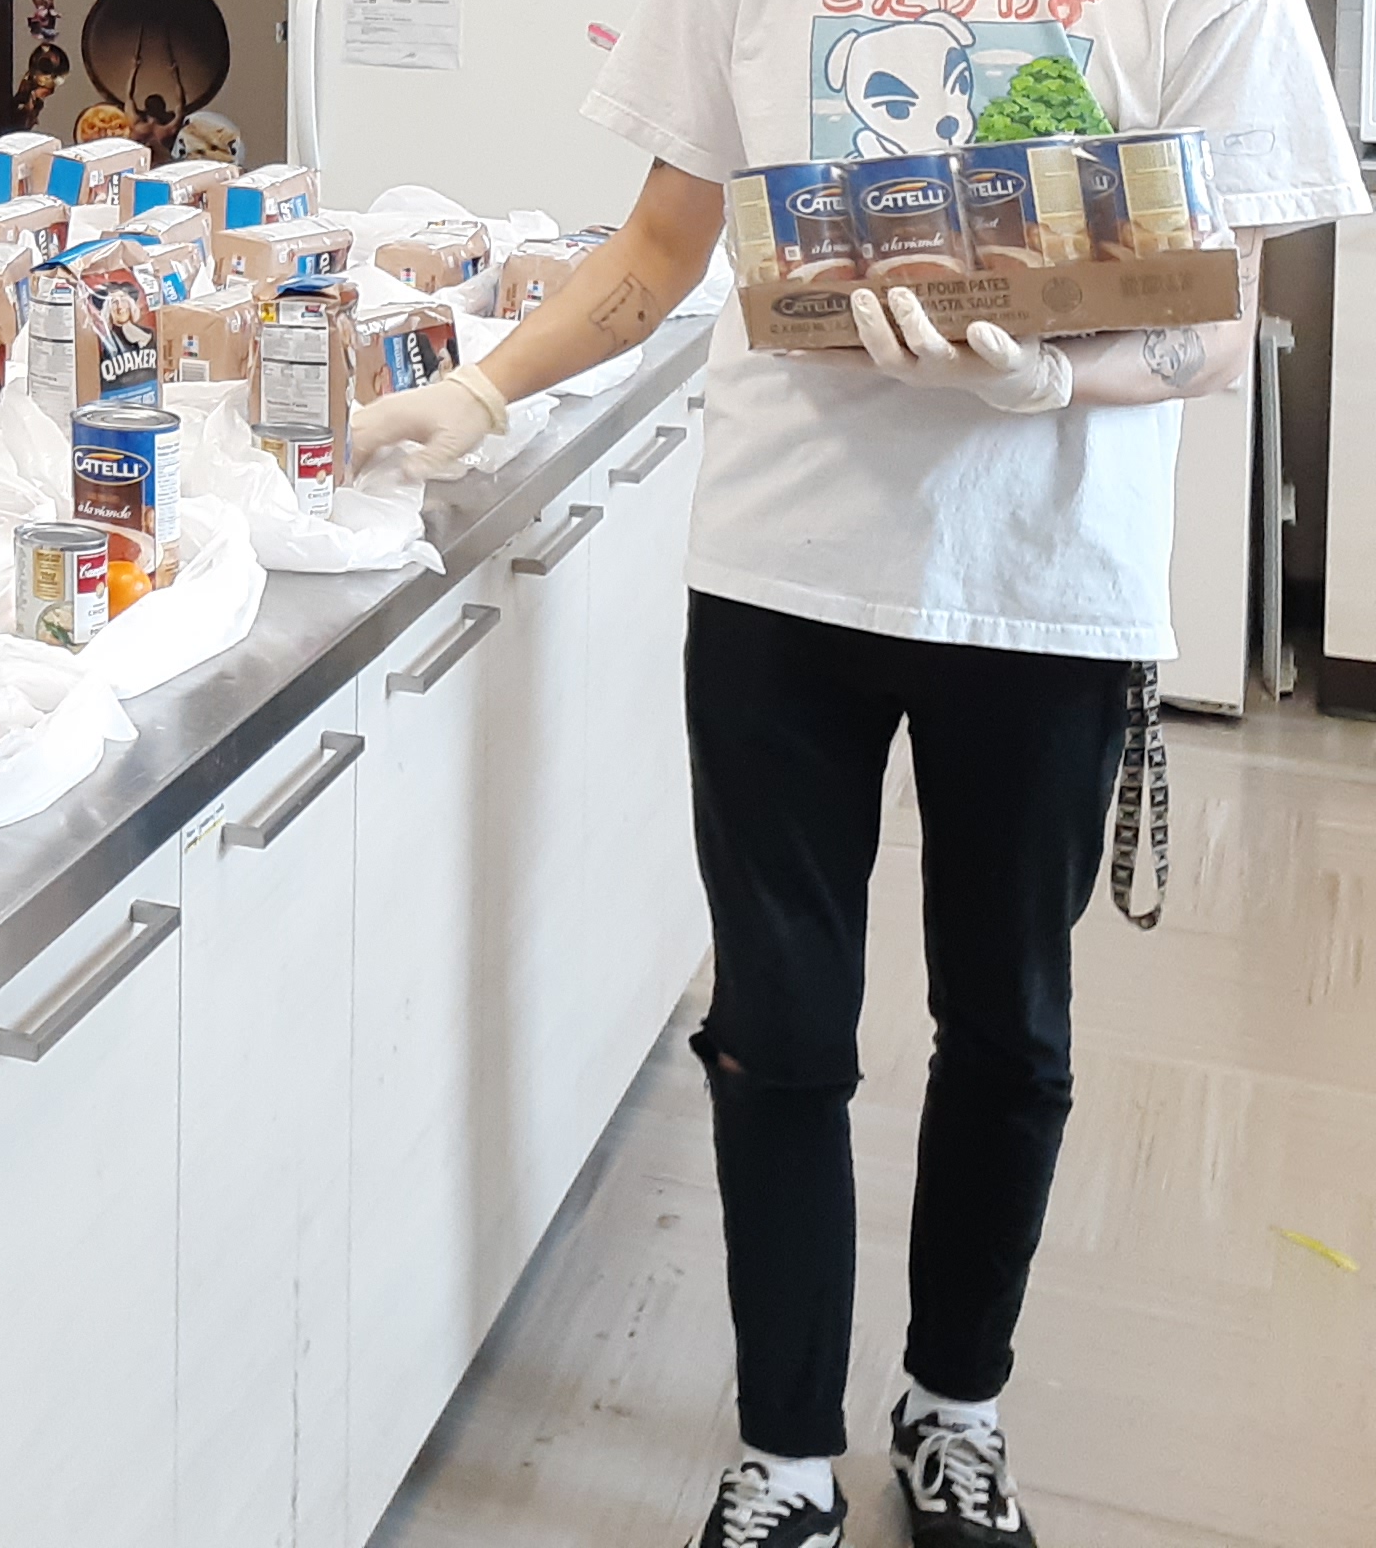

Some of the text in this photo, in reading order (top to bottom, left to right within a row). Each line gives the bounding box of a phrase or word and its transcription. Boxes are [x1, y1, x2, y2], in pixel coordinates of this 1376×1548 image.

[866, 188, 944, 211] CATELLI
[927, 281, 967, 297] POUR
[967, 295, 1011, 310] SAUCE
[100, 348, 157, 382] QUAKER
[74, 451, 140, 478] CATELLI
